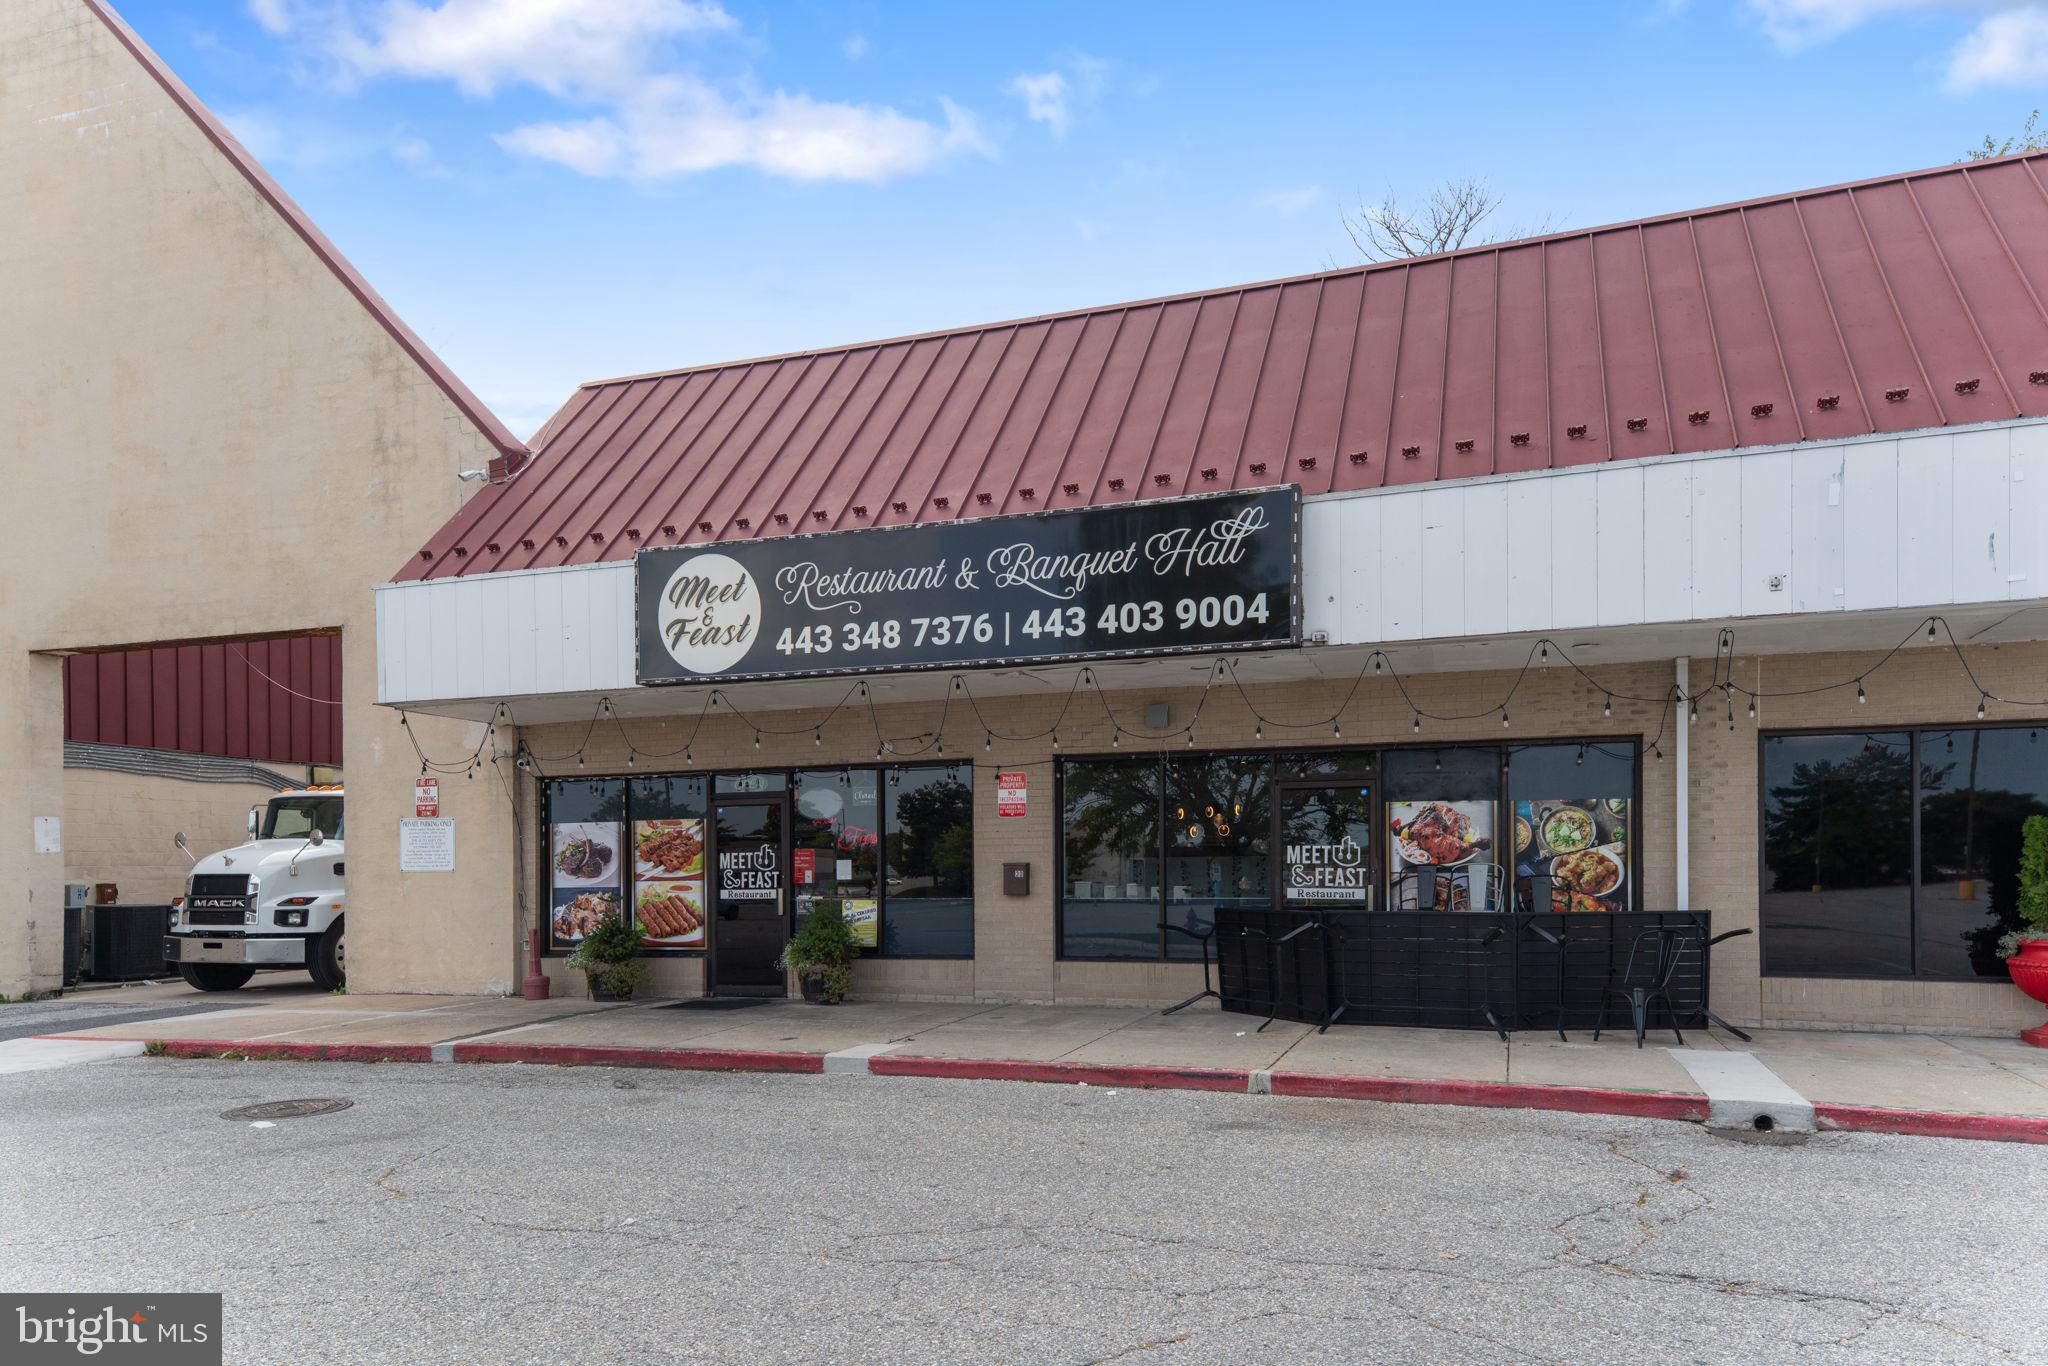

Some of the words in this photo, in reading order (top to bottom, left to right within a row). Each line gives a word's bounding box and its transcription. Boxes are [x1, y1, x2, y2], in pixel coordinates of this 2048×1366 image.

[775, 558, 947, 614] Restaurant
[954, 557, 980, 590] &
[987, 541, 1138, 600] Banquet
[1145, 505, 1270, 577] Hall
[668, 572, 748, 609] Meet
[702, 606, 714, 627] &
[775, 624, 833, 655] 443
[842, 619, 901, 652] 348
[911, 612, 994, 647] 7376
[1022, 606, 1086, 640] 443
[1097, 600, 1164, 635] 403
[1175, 592, 1270, 630] 9004
[665, 613, 752, 651] Feast
[720, 852, 753, 869] MEET
[1286, 845, 1332, 864] MEET
[723, 869, 741, 889] &
[741, 871, 780, 888] FEAST
[1291, 864, 1314, 887] &
[1314, 867, 1367, 887] FEAST
[193, 899, 245, 907] MACK
[728, 890, 772, 898] Restaurant
[1297, 888, 1356, 899] Restaurant
